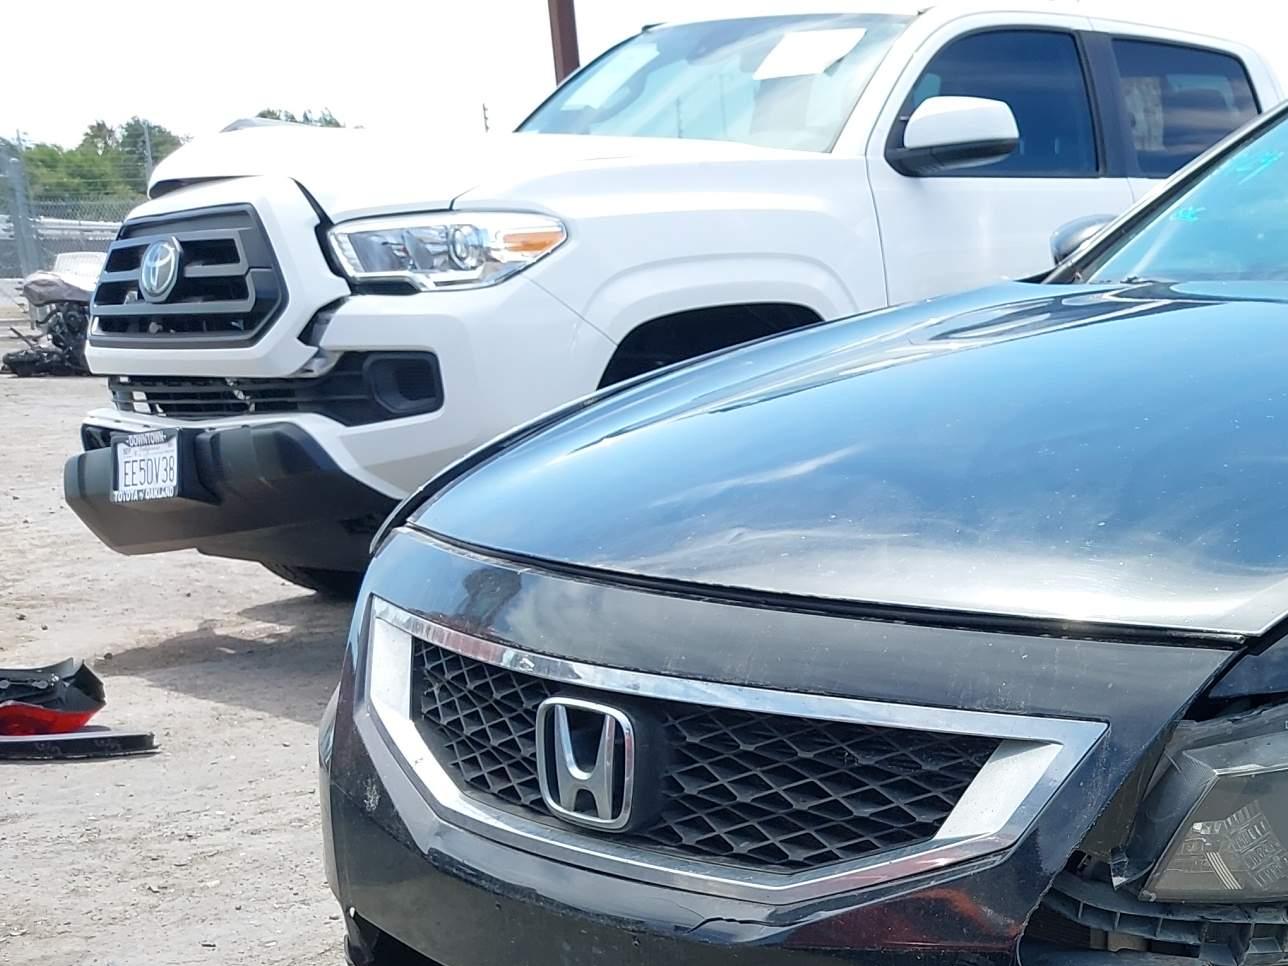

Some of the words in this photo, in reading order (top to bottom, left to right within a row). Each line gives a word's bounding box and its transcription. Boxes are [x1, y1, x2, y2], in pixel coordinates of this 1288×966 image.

[128, 431, 164, 447] DOWNTOWN
[113, 489, 138, 502] TOYOTA
[145, 486, 174, 500] OAKLAND
